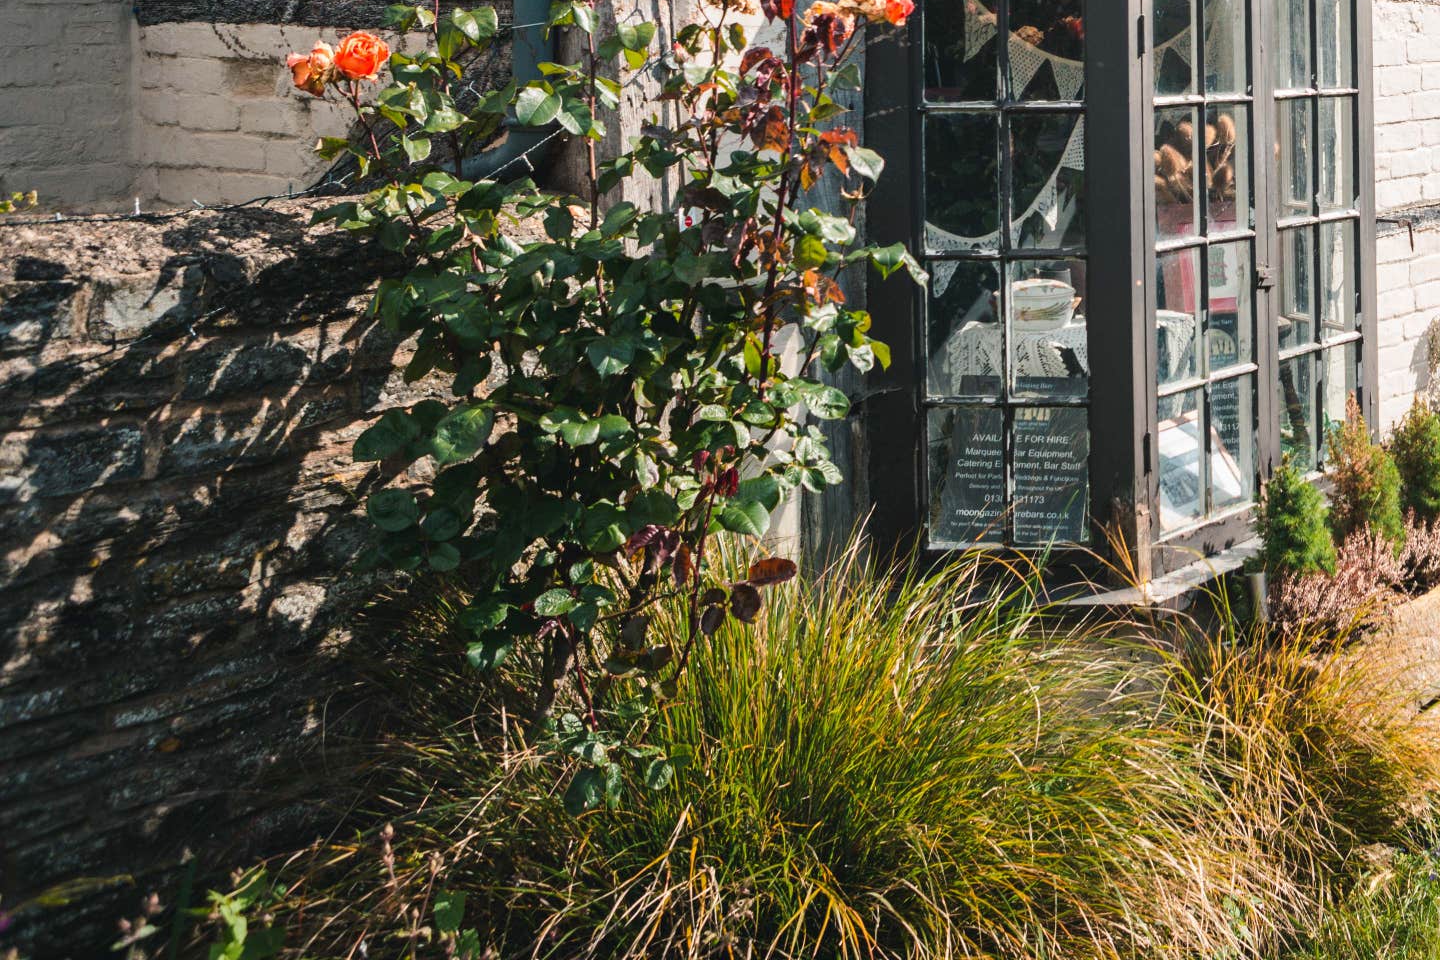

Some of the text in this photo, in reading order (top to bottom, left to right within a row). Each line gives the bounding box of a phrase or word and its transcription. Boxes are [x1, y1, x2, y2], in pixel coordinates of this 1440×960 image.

[972, 433, 1070, 444] AVAILAE FOR HIRE
[957, 458, 993, 469] Catering
[1044, 461, 1059, 470] Bar
[1060, 461, 1081, 471] Staff
